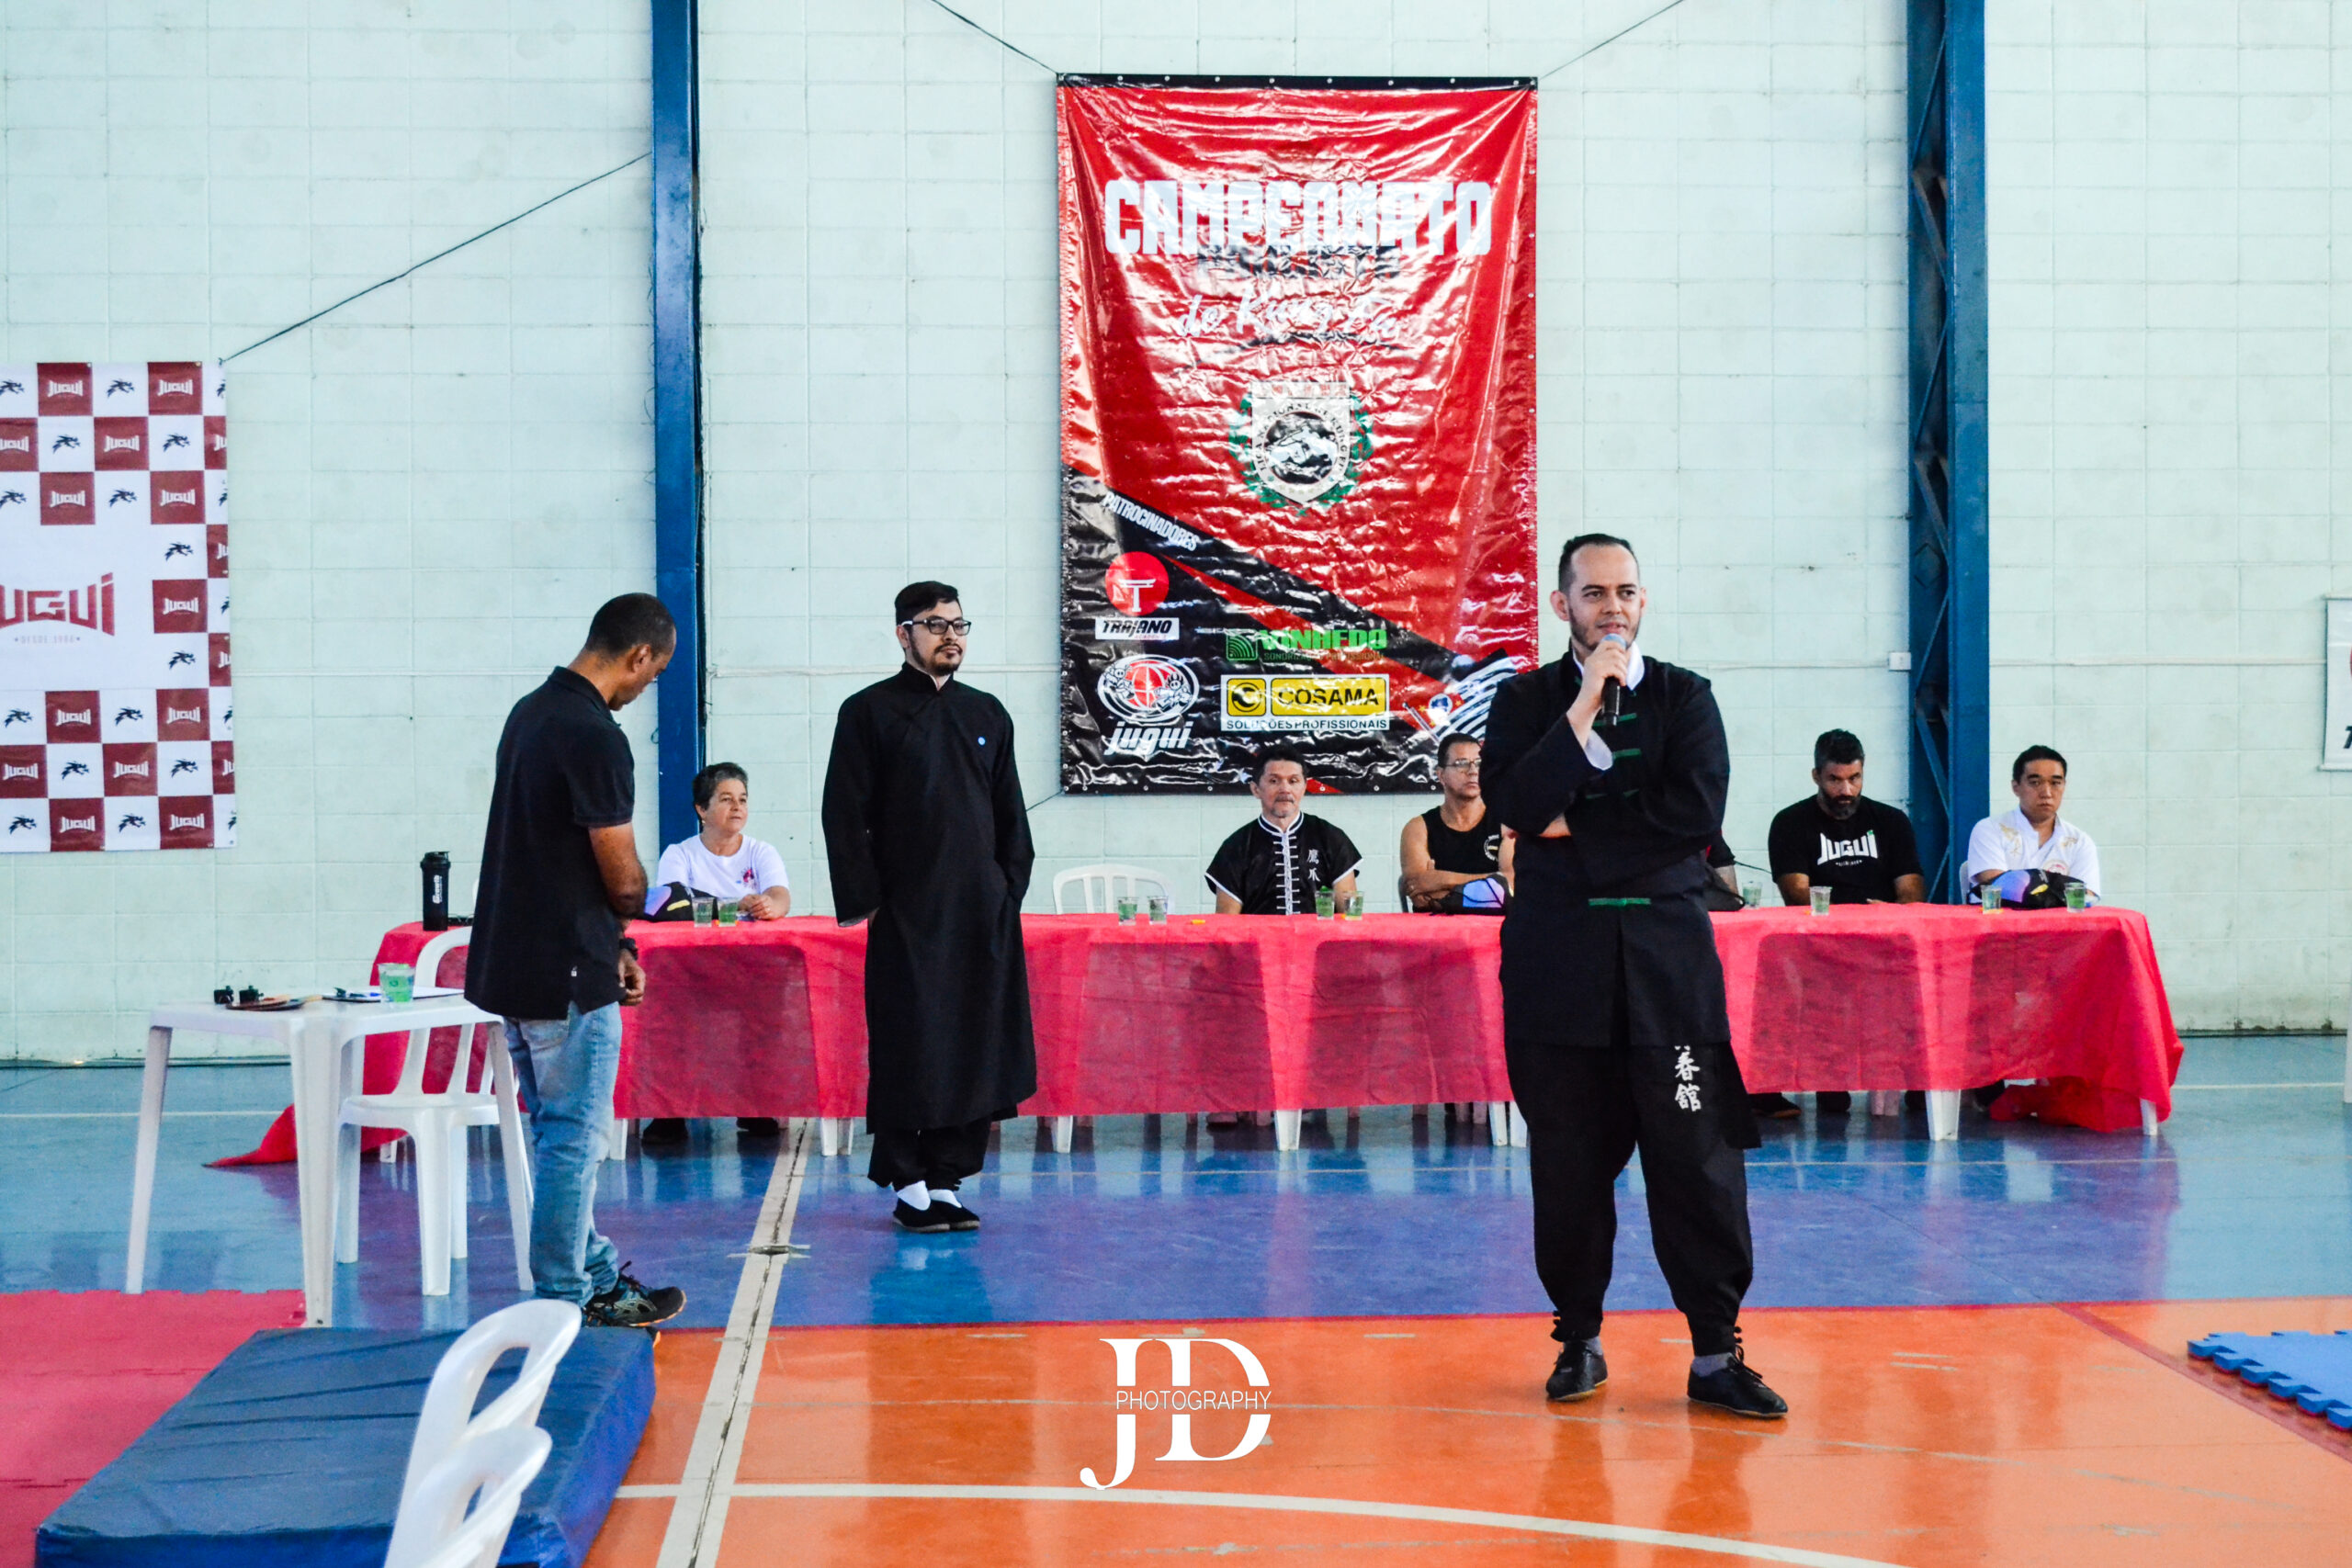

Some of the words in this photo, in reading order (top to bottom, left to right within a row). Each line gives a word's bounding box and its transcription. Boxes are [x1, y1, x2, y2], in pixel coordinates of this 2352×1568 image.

[1104, 179, 1492, 256] CAMPEONATO
[1102, 491, 1201, 551] PATROCINADORES
[1102, 619, 1172, 638] TRAJANO
[1277, 687, 1380, 706] COSAMA
[1295, 719, 1387, 729] PROFISSIONAIS
